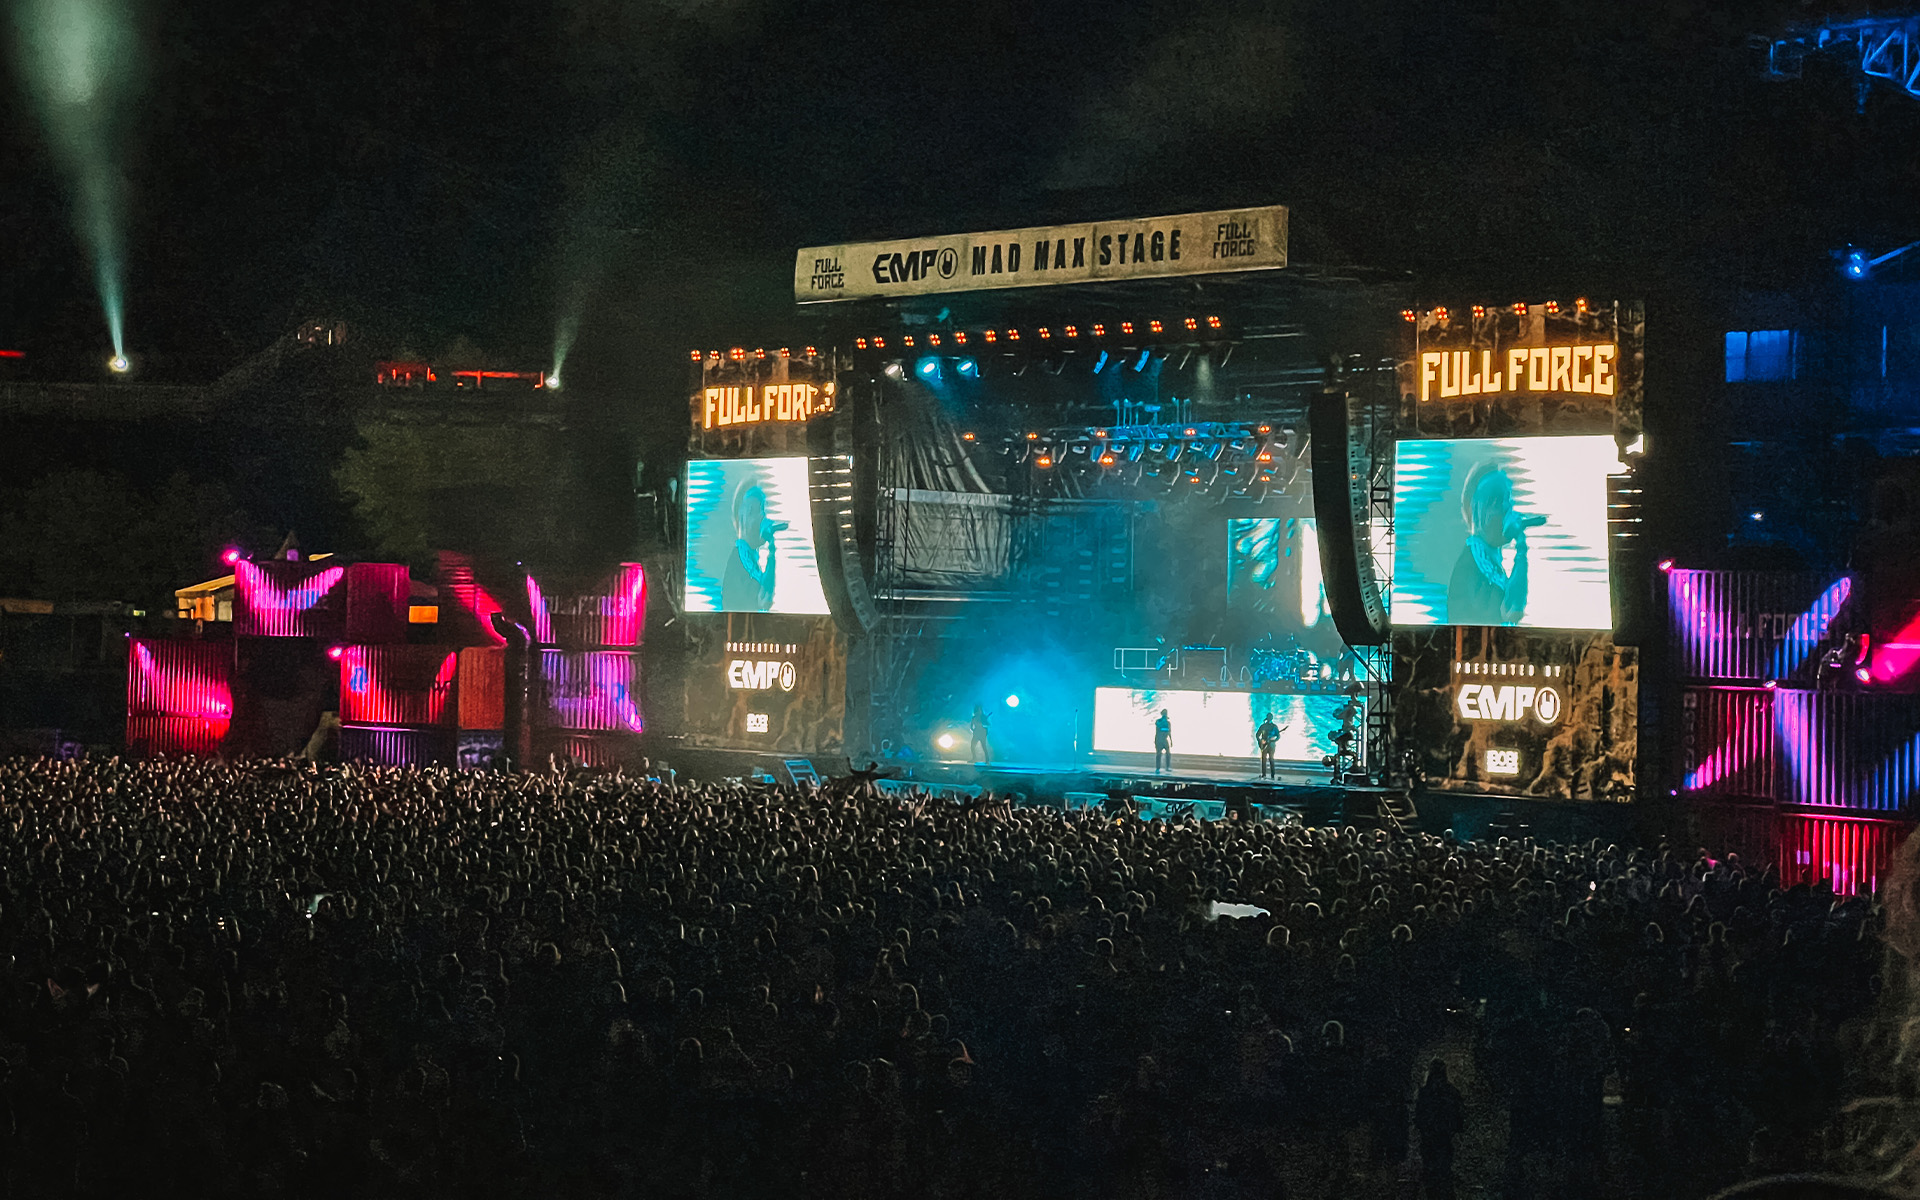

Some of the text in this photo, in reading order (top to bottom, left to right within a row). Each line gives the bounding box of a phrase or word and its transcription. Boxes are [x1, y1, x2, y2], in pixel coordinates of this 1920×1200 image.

[1217, 222, 1251, 241] FULL
[972, 243, 1021, 276] MAD
[1034, 236, 1086, 270] MAX
[1100, 229, 1181, 266] STAGE
[1213, 239, 1255, 259] FORCE
[814, 257, 842, 274] FULL
[811, 273, 845, 290] FORCE
[1421, 344, 1615, 402] FULL FORCE
[705, 386, 761, 430] FULL
[1456, 662, 1535, 677] PRESENTED
